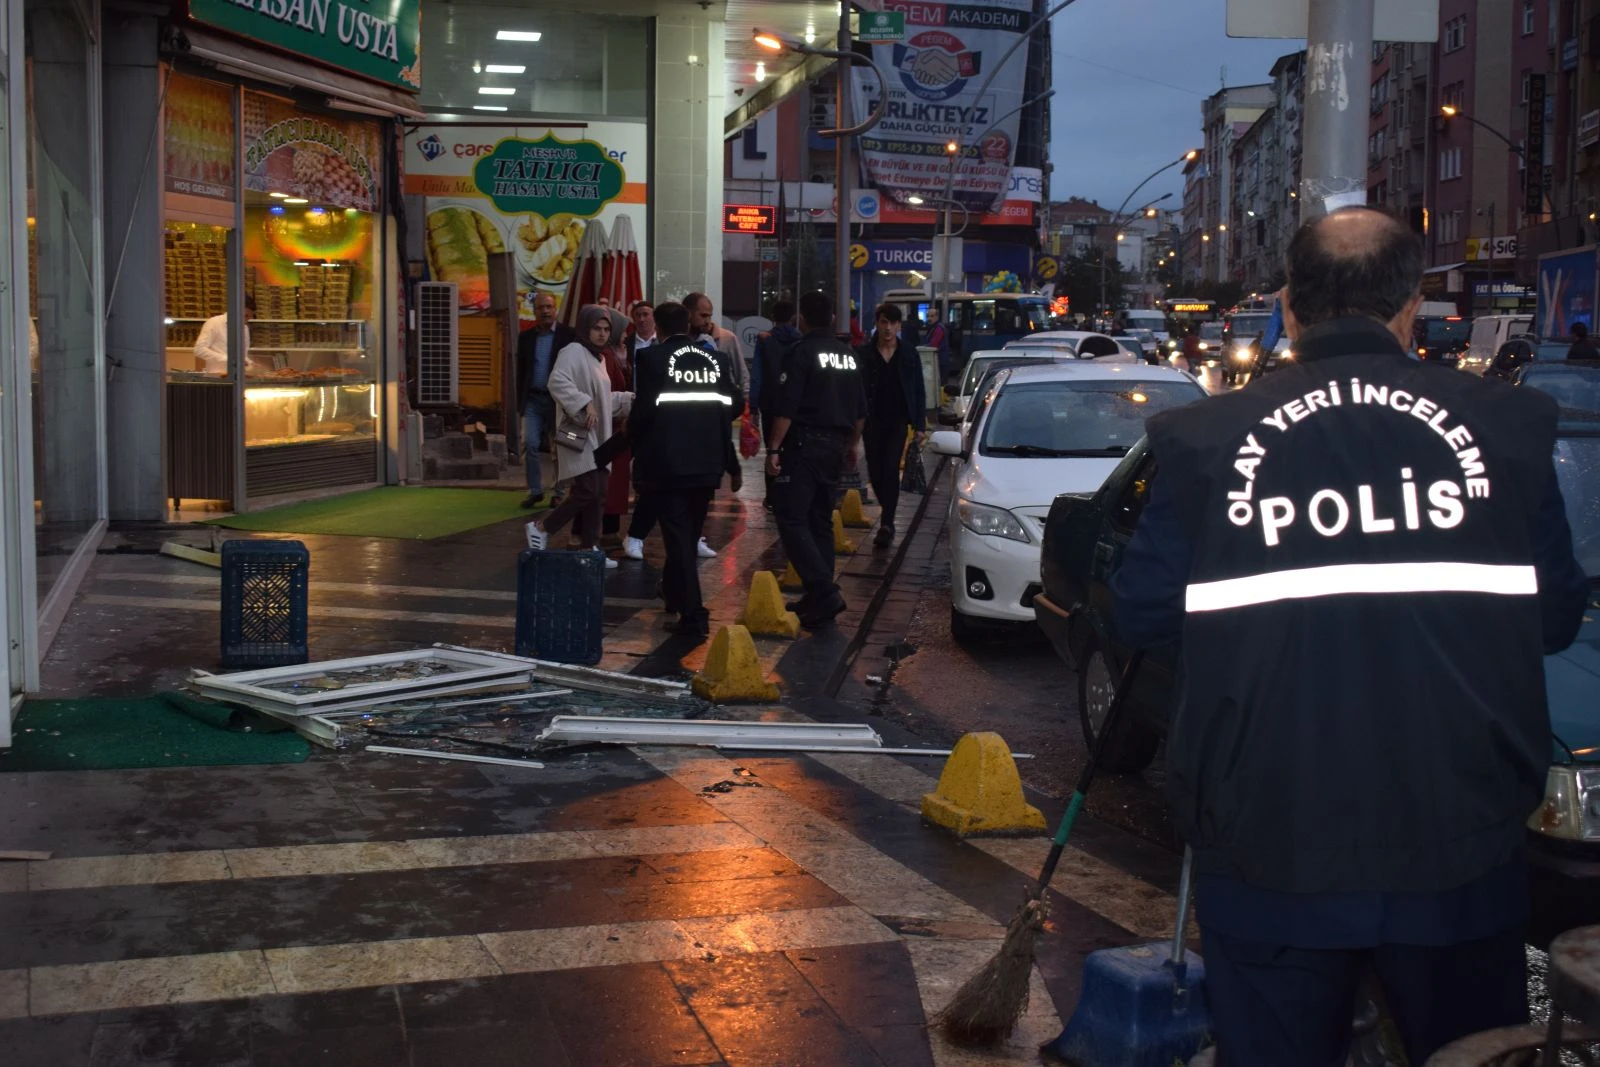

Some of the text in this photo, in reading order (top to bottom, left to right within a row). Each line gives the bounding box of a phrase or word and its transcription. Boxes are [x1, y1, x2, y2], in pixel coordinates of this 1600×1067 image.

[949, 12, 1020, 27] AKADEMİ
[338, 4, 399, 61] USTA
[868, 100, 988, 125] BRLİKTEYZ
[880, 120, 974, 136] DAHA GÜÇLÜYZ
[492, 159, 604, 183] TATLICI
[913, 162, 925, 172] VE
[939, 163, 968, 175] GÜLÜ
[453, 181, 476, 193] Ma
[493, 181, 601, 200] HASAN USTA
[1002, 207, 1029, 217] EGEM
[875, 249, 932, 264] TURKCE
[1476, 284, 1501, 294] FATRA
[668, 356, 677, 377] OLAY
[673, 345, 691, 356] YERİ
[818, 352, 857, 370] POLİS
[674, 367, 717, 384] POLİS
[1227, 377, 1491, 526] OLAY YERİ İNCELEME
[1259, 466, 1464, 547] POLİS
